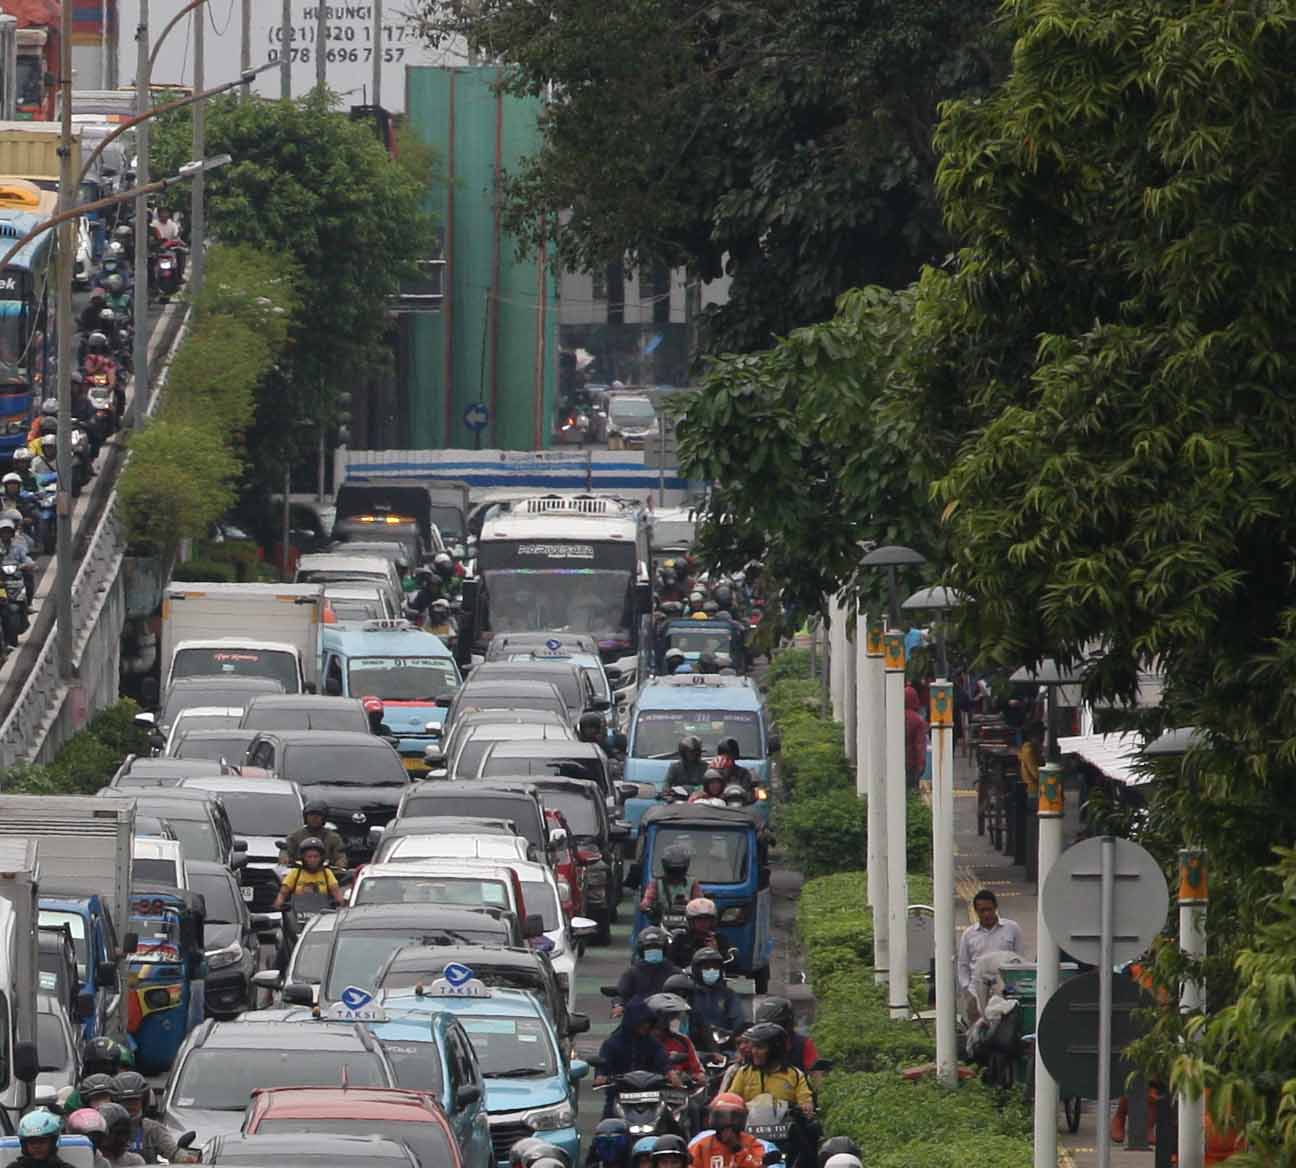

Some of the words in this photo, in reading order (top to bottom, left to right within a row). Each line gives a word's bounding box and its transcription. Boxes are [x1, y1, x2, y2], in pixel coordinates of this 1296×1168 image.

[267, 48, 310, 63] 078
[363, 48, 405, 63] 757
[335, 1010, 376, 1019] TAKSI
